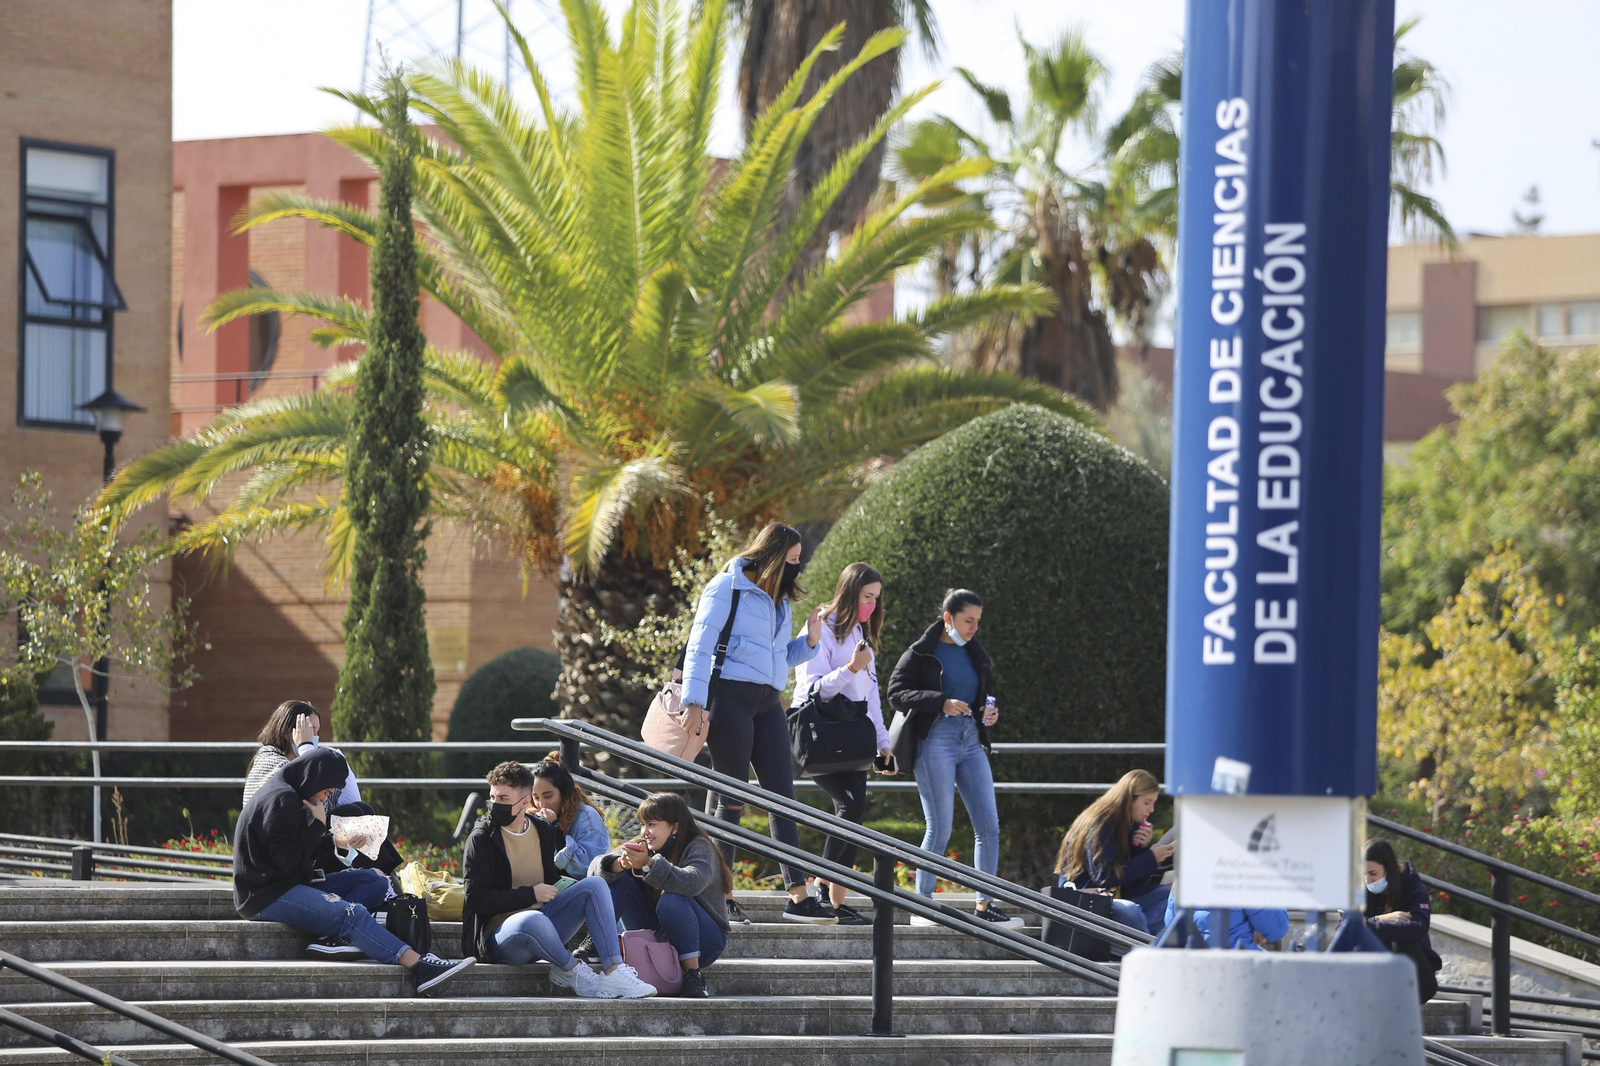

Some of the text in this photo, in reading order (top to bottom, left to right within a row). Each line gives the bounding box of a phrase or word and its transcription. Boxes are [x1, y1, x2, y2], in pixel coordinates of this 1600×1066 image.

[1203, 96, 1251, 667] FACULTAD DE CIENCIAS
[1254, 223, 1306, 663] DE LA EDUCACIÓN
